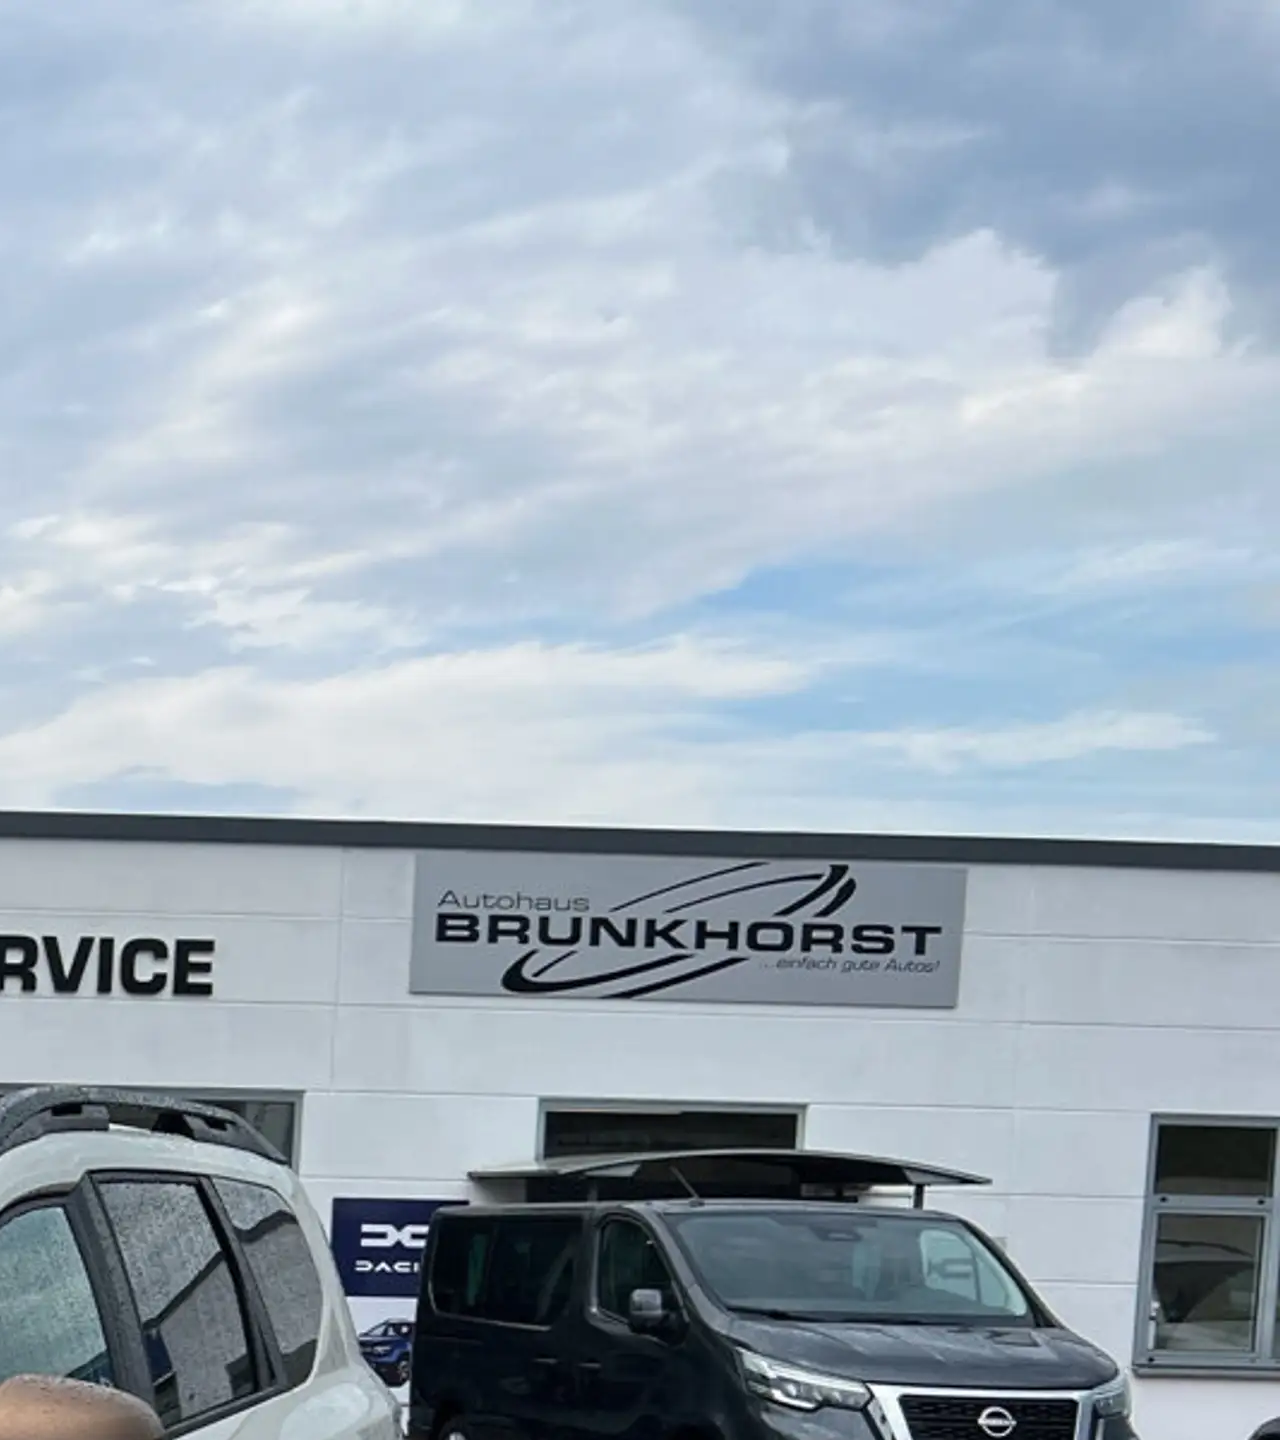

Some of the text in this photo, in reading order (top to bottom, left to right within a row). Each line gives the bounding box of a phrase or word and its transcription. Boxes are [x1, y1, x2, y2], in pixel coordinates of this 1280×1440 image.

[438, 889, 590, 912] Autohaus
[435, 912, 942, 956] BRUNKHORST
[841, 958, 881, 976] gute
[885, 958, 941, 974] Autos!
[354, 1259, 421, 1274] DACI
